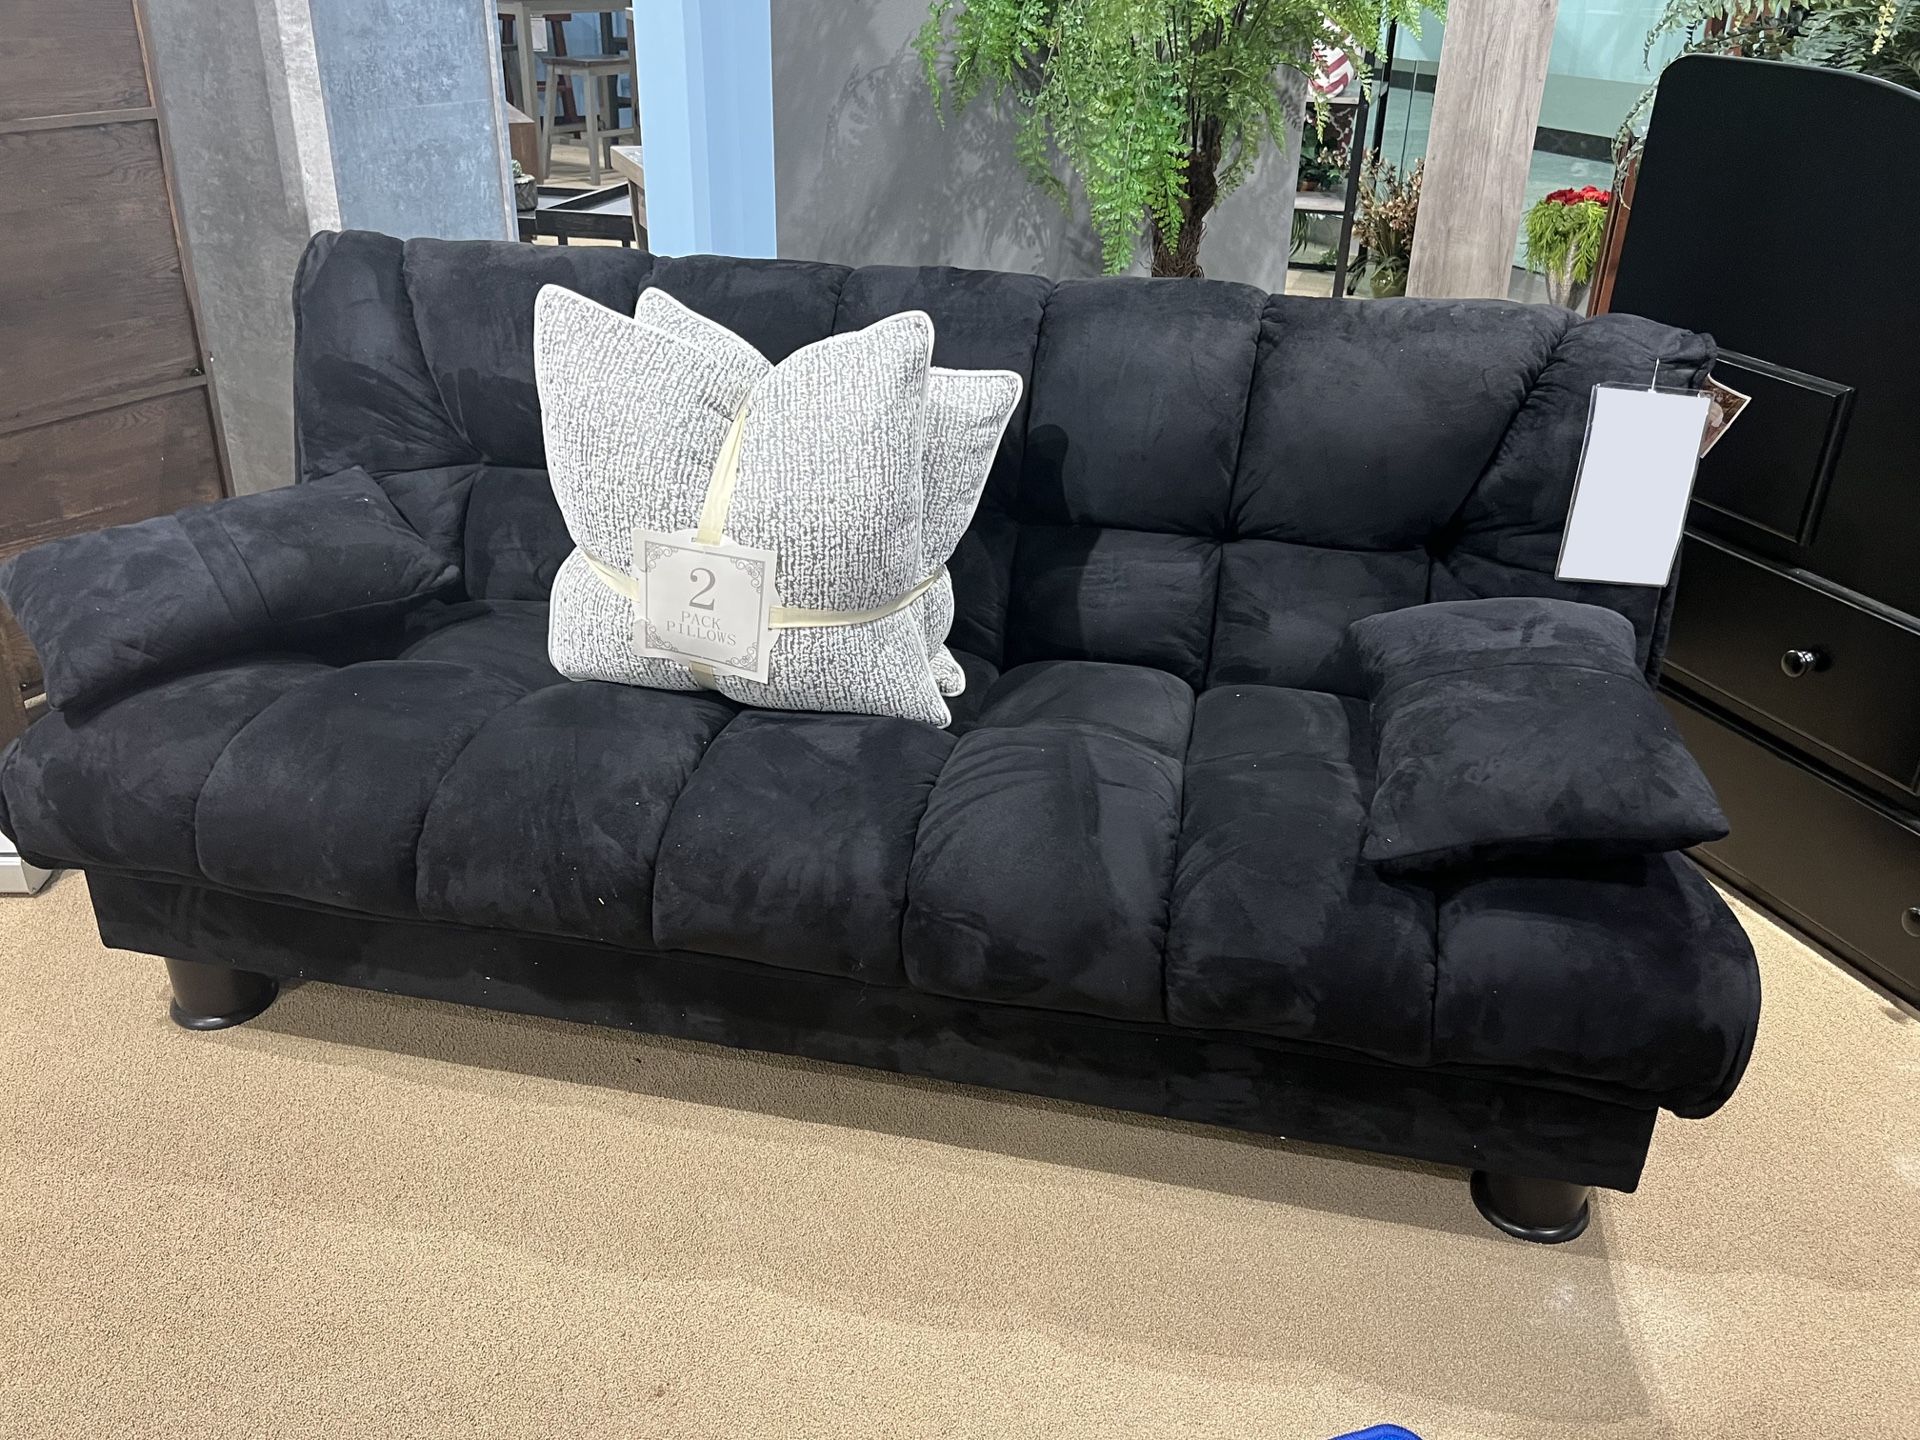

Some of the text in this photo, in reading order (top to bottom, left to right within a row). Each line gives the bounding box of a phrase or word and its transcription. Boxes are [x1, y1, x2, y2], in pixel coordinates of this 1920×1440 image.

[689, 567, 716, 611] 2
[666, 620, 737, 646] PILLOWS
[681, 611, 721, 630] PACK
